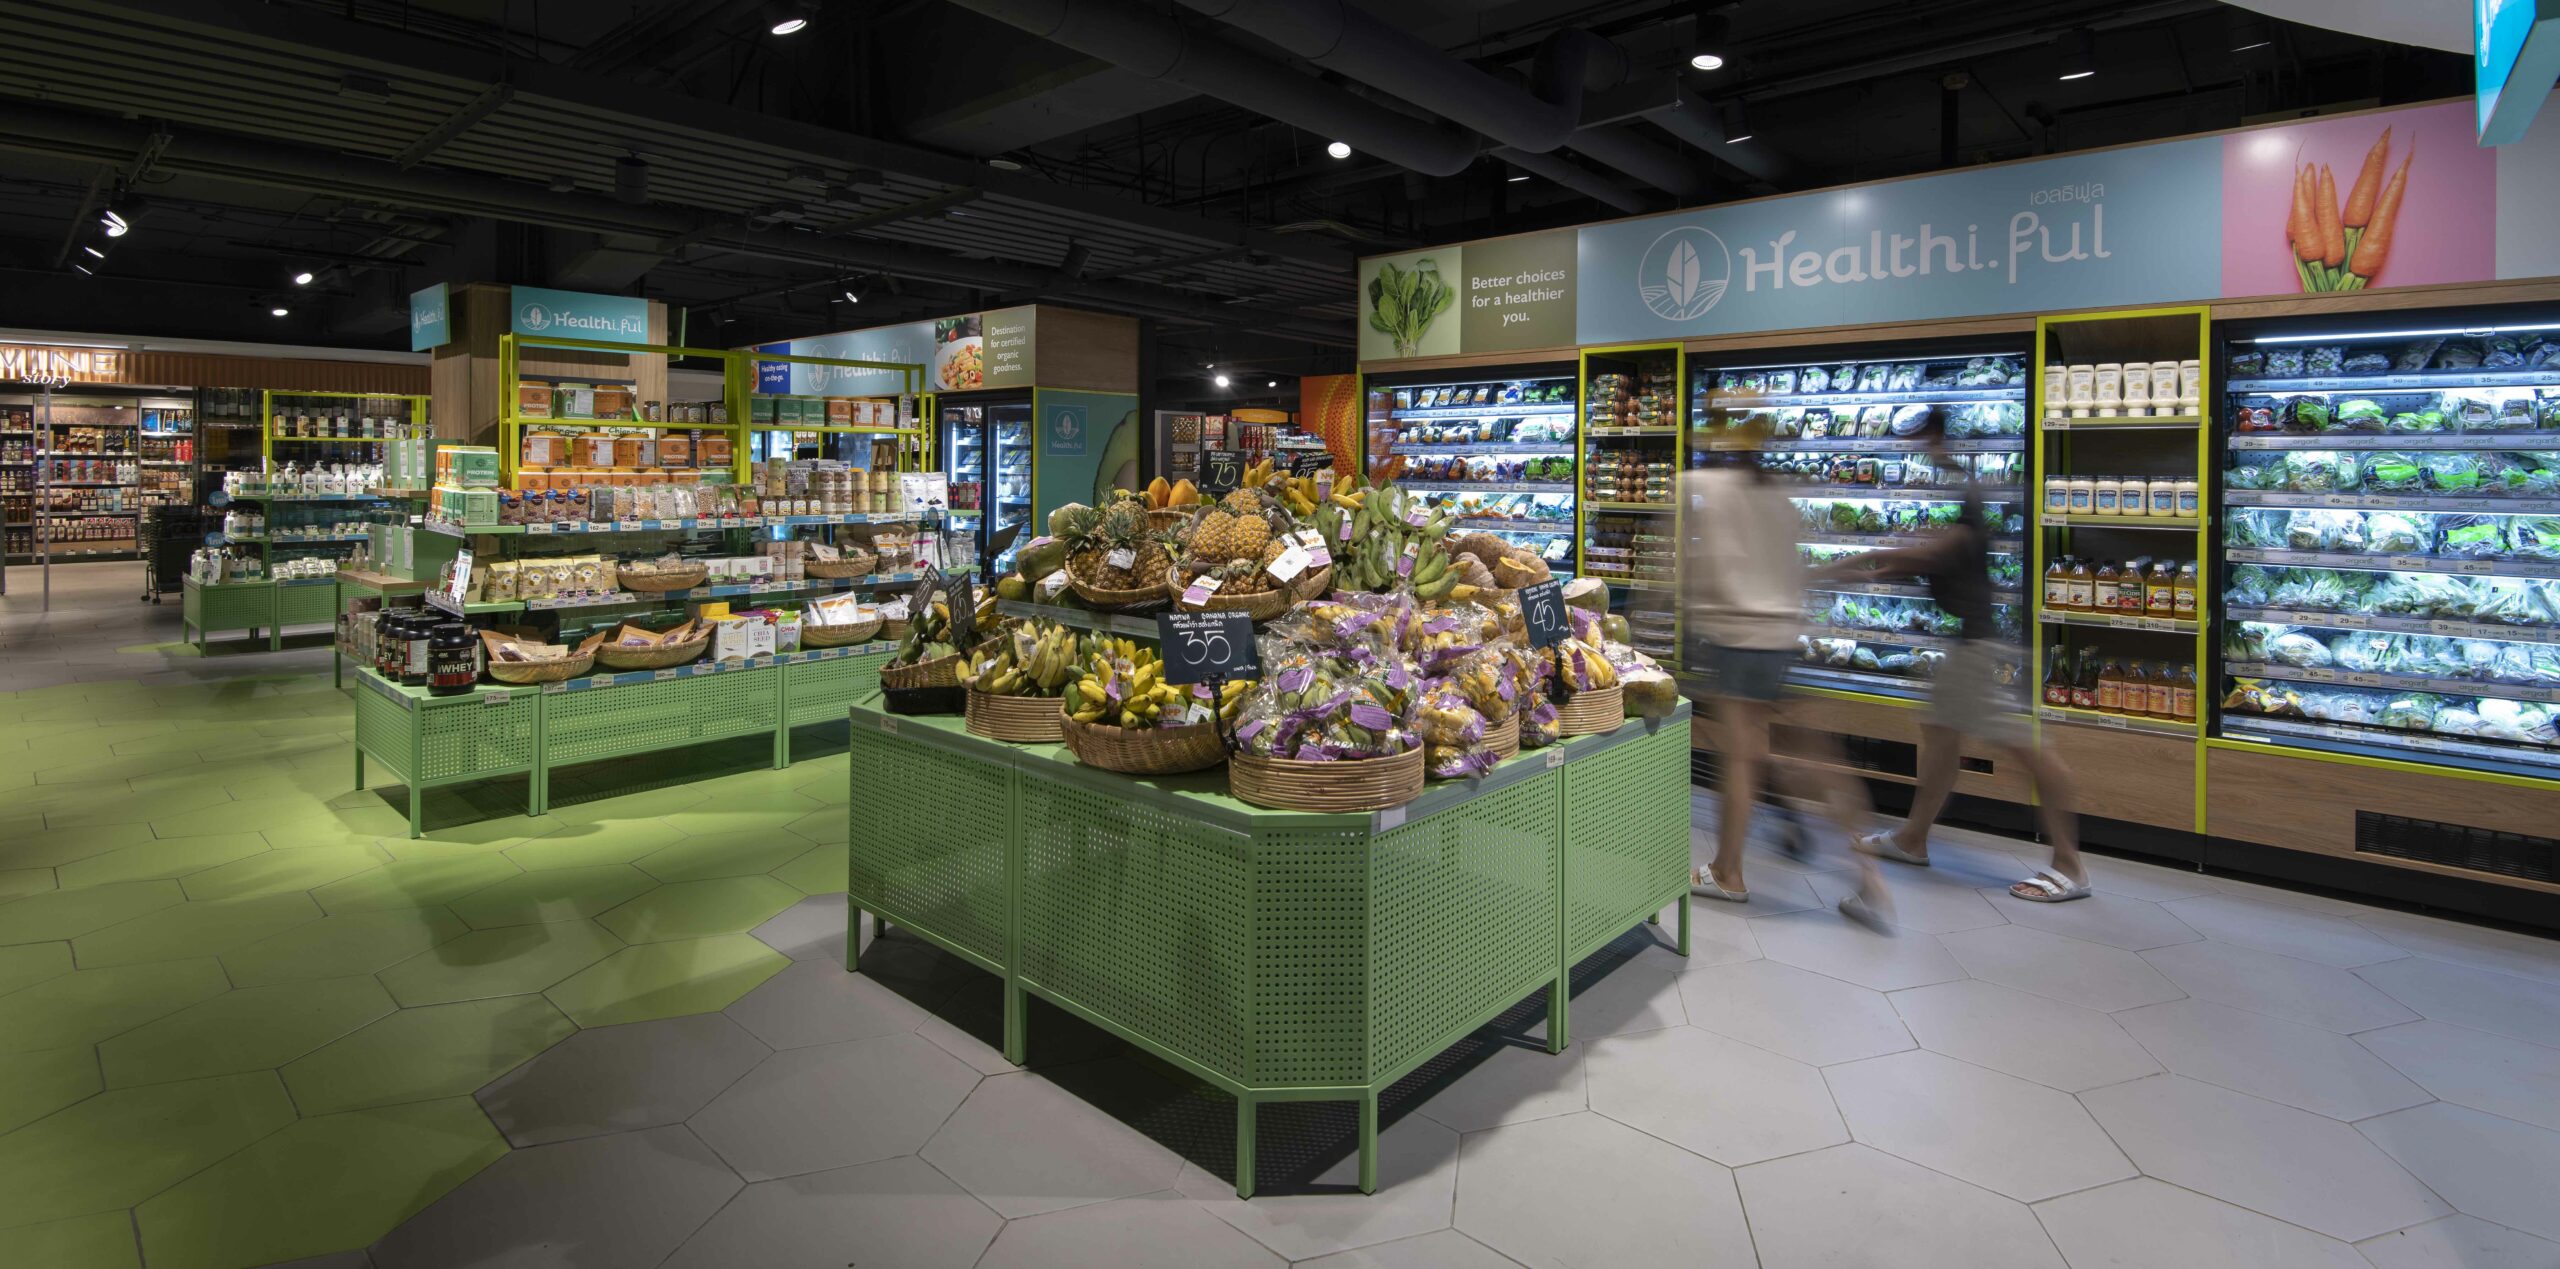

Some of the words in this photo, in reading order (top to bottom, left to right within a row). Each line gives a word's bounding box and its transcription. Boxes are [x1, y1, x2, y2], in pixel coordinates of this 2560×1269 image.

[1739, 204, 2112, 292] Healthi.ful
[1472, 276, 1512, 290] Better
[1516, 269, 1566, 285] choices
[1472, 295, 1490, 308] for
[1494, 297, 1501, 306] a
[1505, 288, 1564, 305] healthier
[553, 311, 642, 336] Healthi.ful
[1503, 311, 1530, 328] you.
[991, 324, 1026, 336] Destination
[991, 339, 999, 348] for
[1001, 336, 1026, 348] certified
[997, 350, 1019, 361] organic
[761, 364, 776, 373] Healthy
[776, 363, 788, 372] eating
[993, 364, 1022, 375] goodness.
[22, 367, 71, 388] story
[2293, 438, 2321, 446] organic
[2347, 437, 2377, 446] organic
[2404, 437, 2433, 445] organic
[2464, 436, 2496, 445] organic
[2527, 436, 2560, 445] organic
[1211, 462, 1239, 486] 75
[2287, 496, 2315, 504] organic
[2400, 498, 2430, 506] organic
[2458, 500, 2490, 508] organic
[2520, 501, 2554, 509] organic
[2291, 554, 2320, 562] organic
[2345, 556, 2375, 565] organic
[2524, 565, 2560, 574] organic
[1201, 612, 1226, 620] BANANA
[1228, 611, 1250, 619] ORGANIC
[1532, 599, 1556, 632] 45
[1179, 630, 1231, 665] 35
[2400, 679, 2430, 688] organic
[2459, 684, 2490, 693] organic
